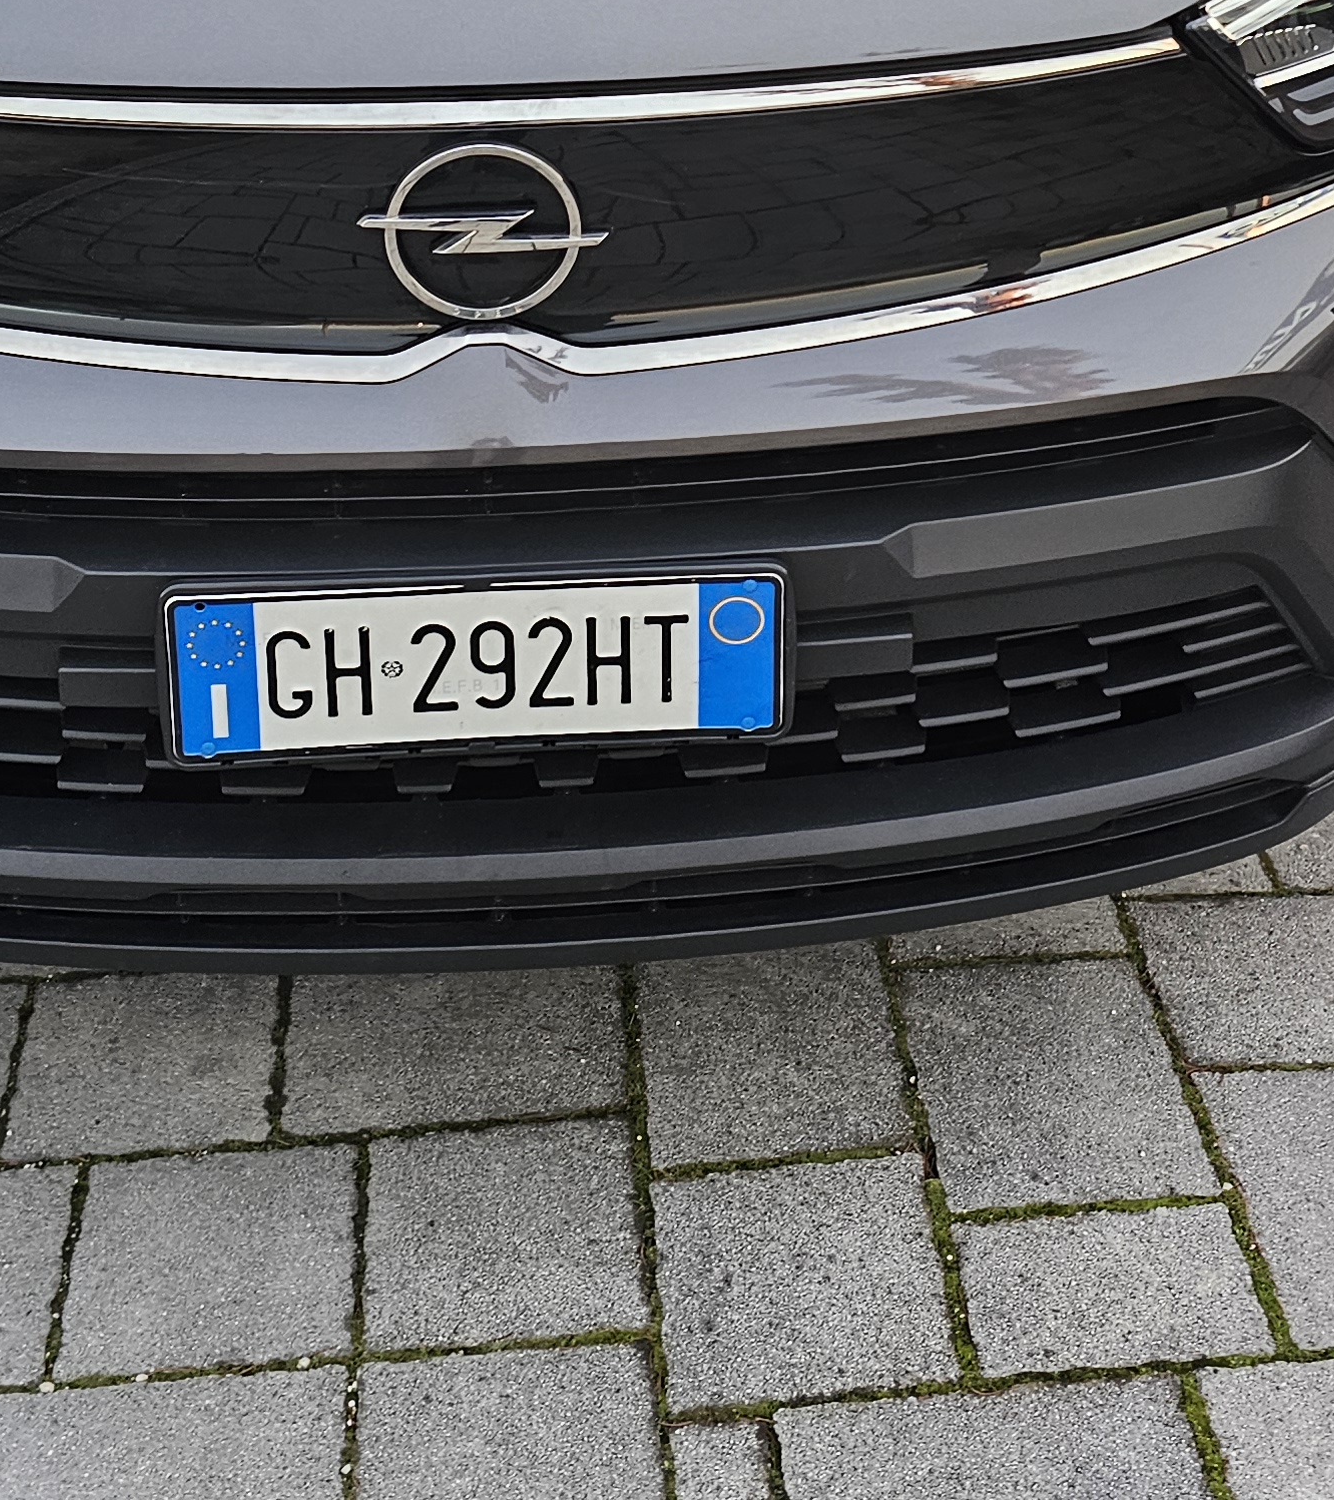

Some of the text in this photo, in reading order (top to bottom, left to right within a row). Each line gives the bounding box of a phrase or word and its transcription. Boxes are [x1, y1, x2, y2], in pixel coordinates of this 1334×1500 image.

[210, 614, 690, 738] I GH 292HT
